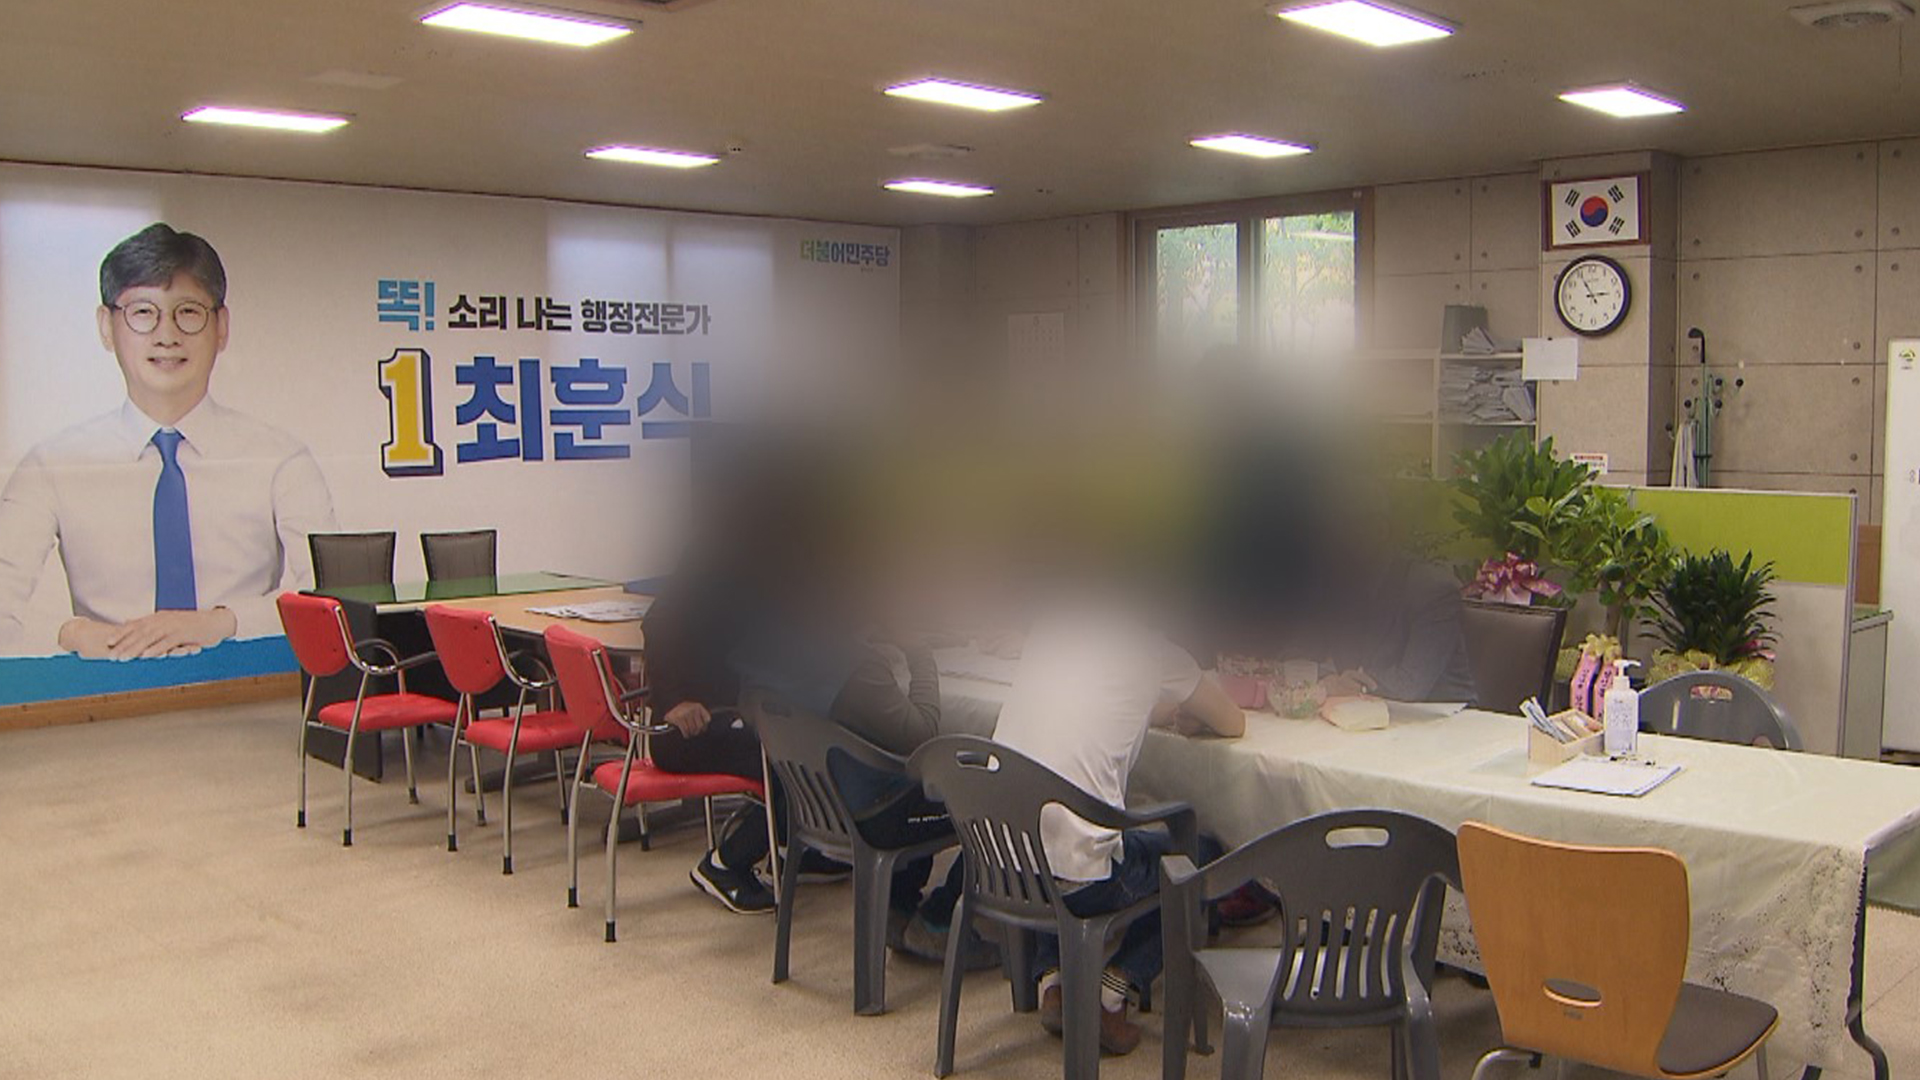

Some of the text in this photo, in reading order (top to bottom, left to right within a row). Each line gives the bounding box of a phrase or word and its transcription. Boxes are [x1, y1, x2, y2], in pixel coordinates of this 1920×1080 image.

[801, 239, 891, 267] 더불어민주당
[377, 279, 711, 335] 똑! 소리 나는 행정전문가
[378, 347, 444, 478] 1
